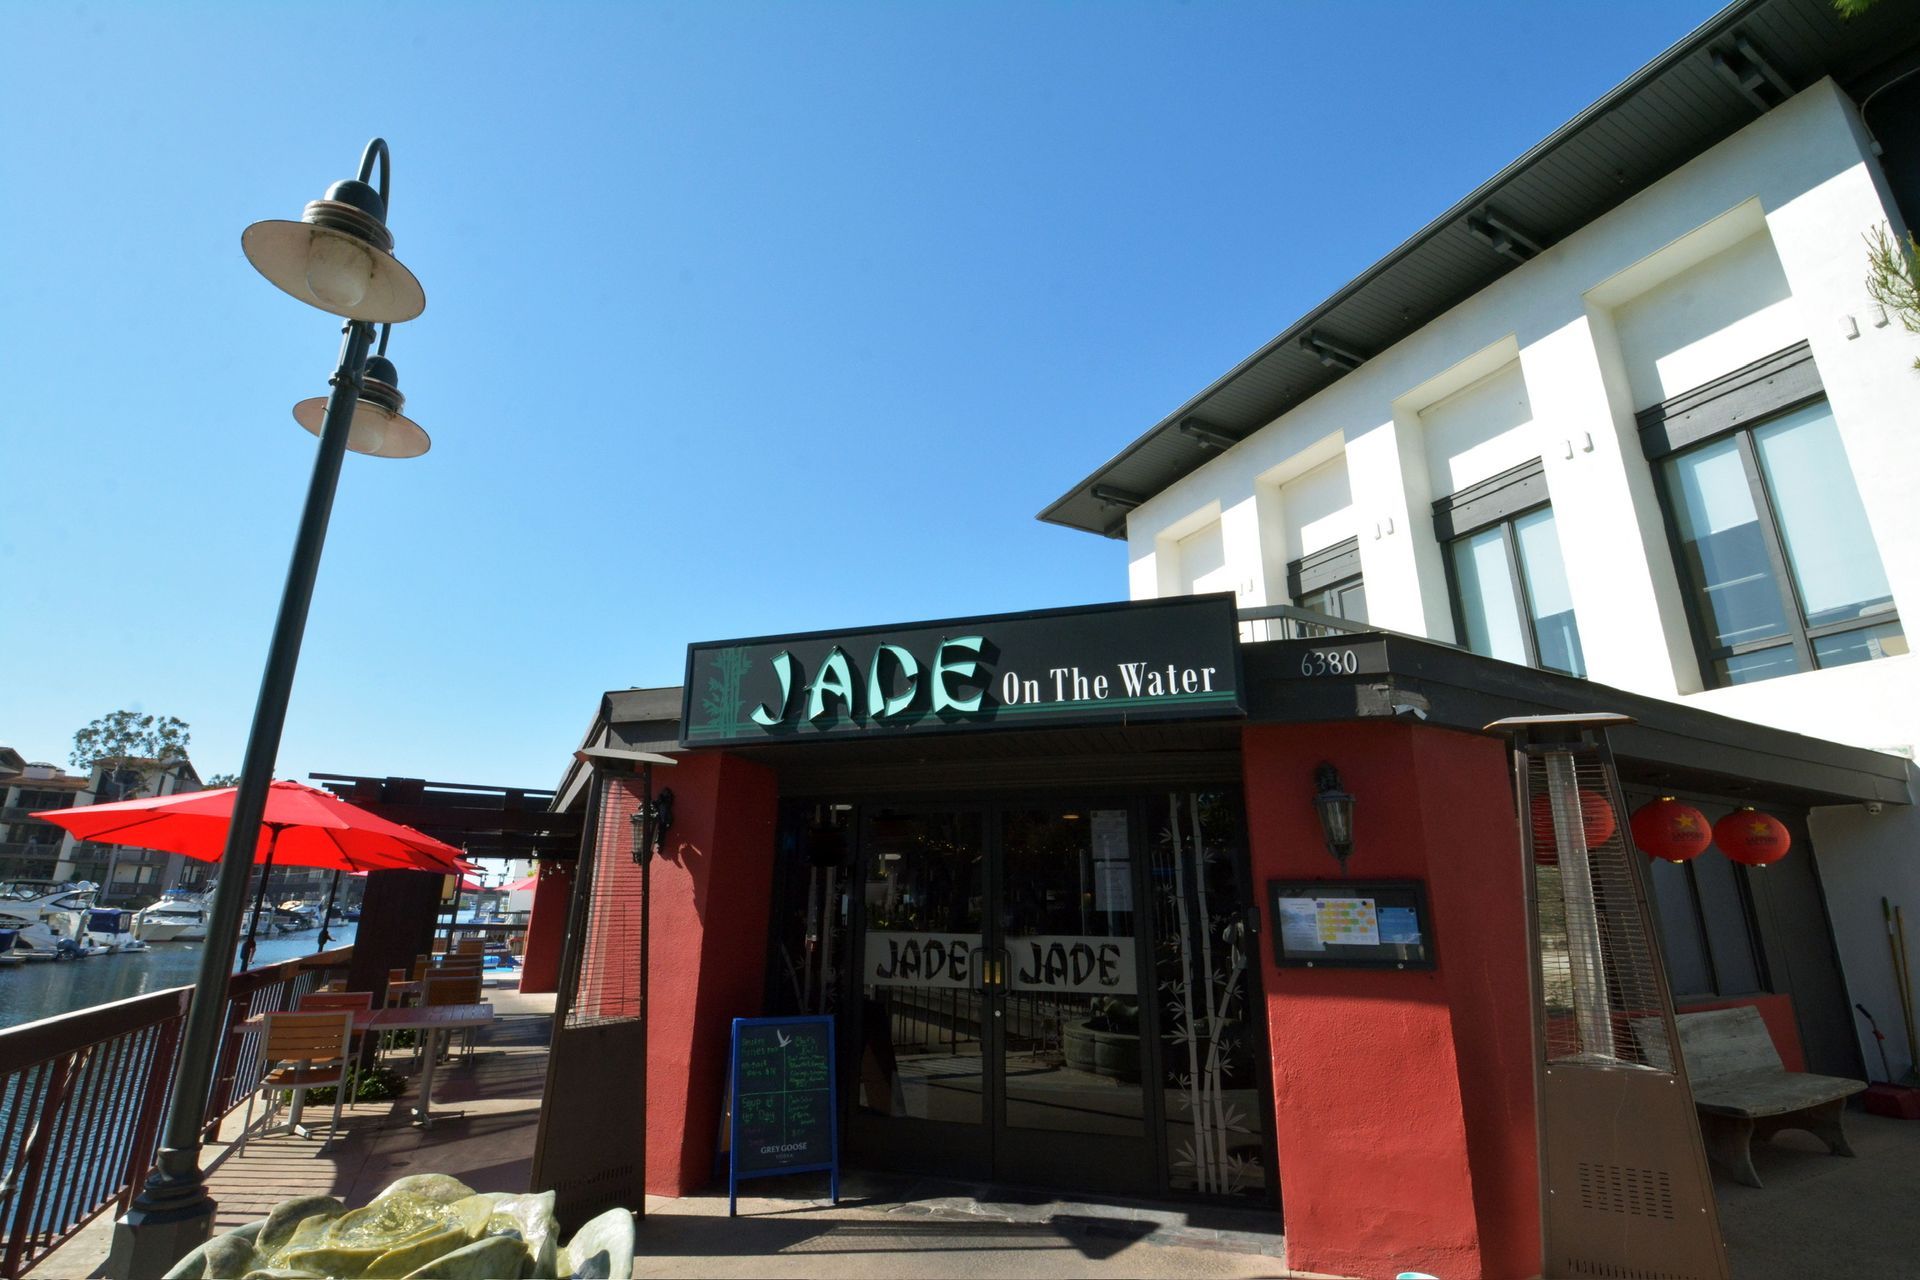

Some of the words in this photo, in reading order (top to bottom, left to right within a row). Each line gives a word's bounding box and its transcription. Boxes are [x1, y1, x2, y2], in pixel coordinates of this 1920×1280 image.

[750, 634, 985, 726] JADE
[1002, 670, 1040, 706] On
[1049, 662, 1109, 703] The
[1117, 661, 1216, 699] Water
[1301, 649, 1357, 677] 6380
[876, 937, 969, 981] JADE
[1018, 940, 1121, 987] JADE
[760, 1145, 780, 1154] GREY
[781, 1142, 807, 1152] GOOSE
